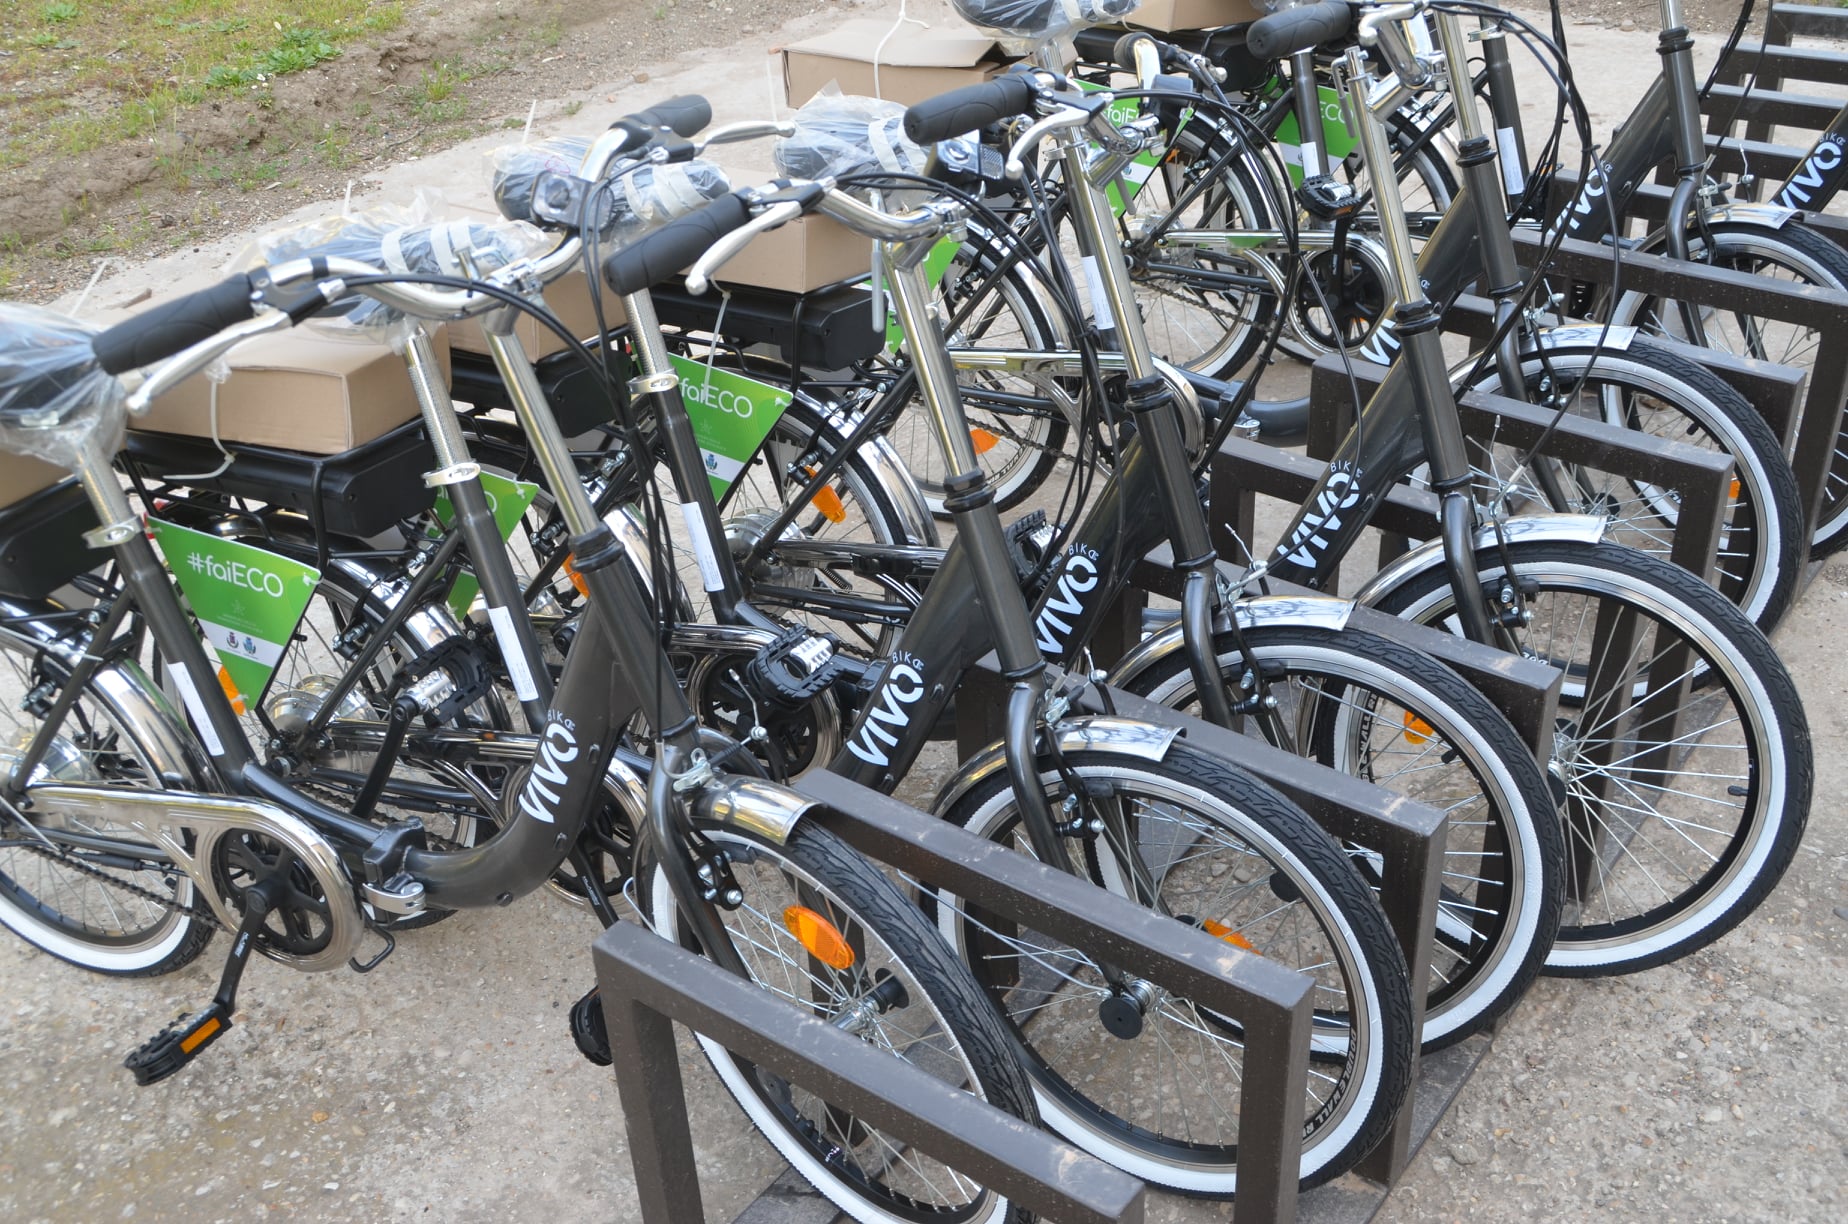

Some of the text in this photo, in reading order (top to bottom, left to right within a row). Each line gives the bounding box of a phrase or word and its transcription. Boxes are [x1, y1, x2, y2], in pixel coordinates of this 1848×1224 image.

[680, 377, 753, 418] faiECO
[1068, 542, 1100, 561] BIKE
[1276, 472, 1360, 568] VIVO
[187, 552, 284, 598] #faiECO
[1036, 556, 1098, 653] VIVO
[892, 650, 925, 672] BIKE
[846, 664, 924, 766] VIVO
[519, 723, 578, 823] VIVO
